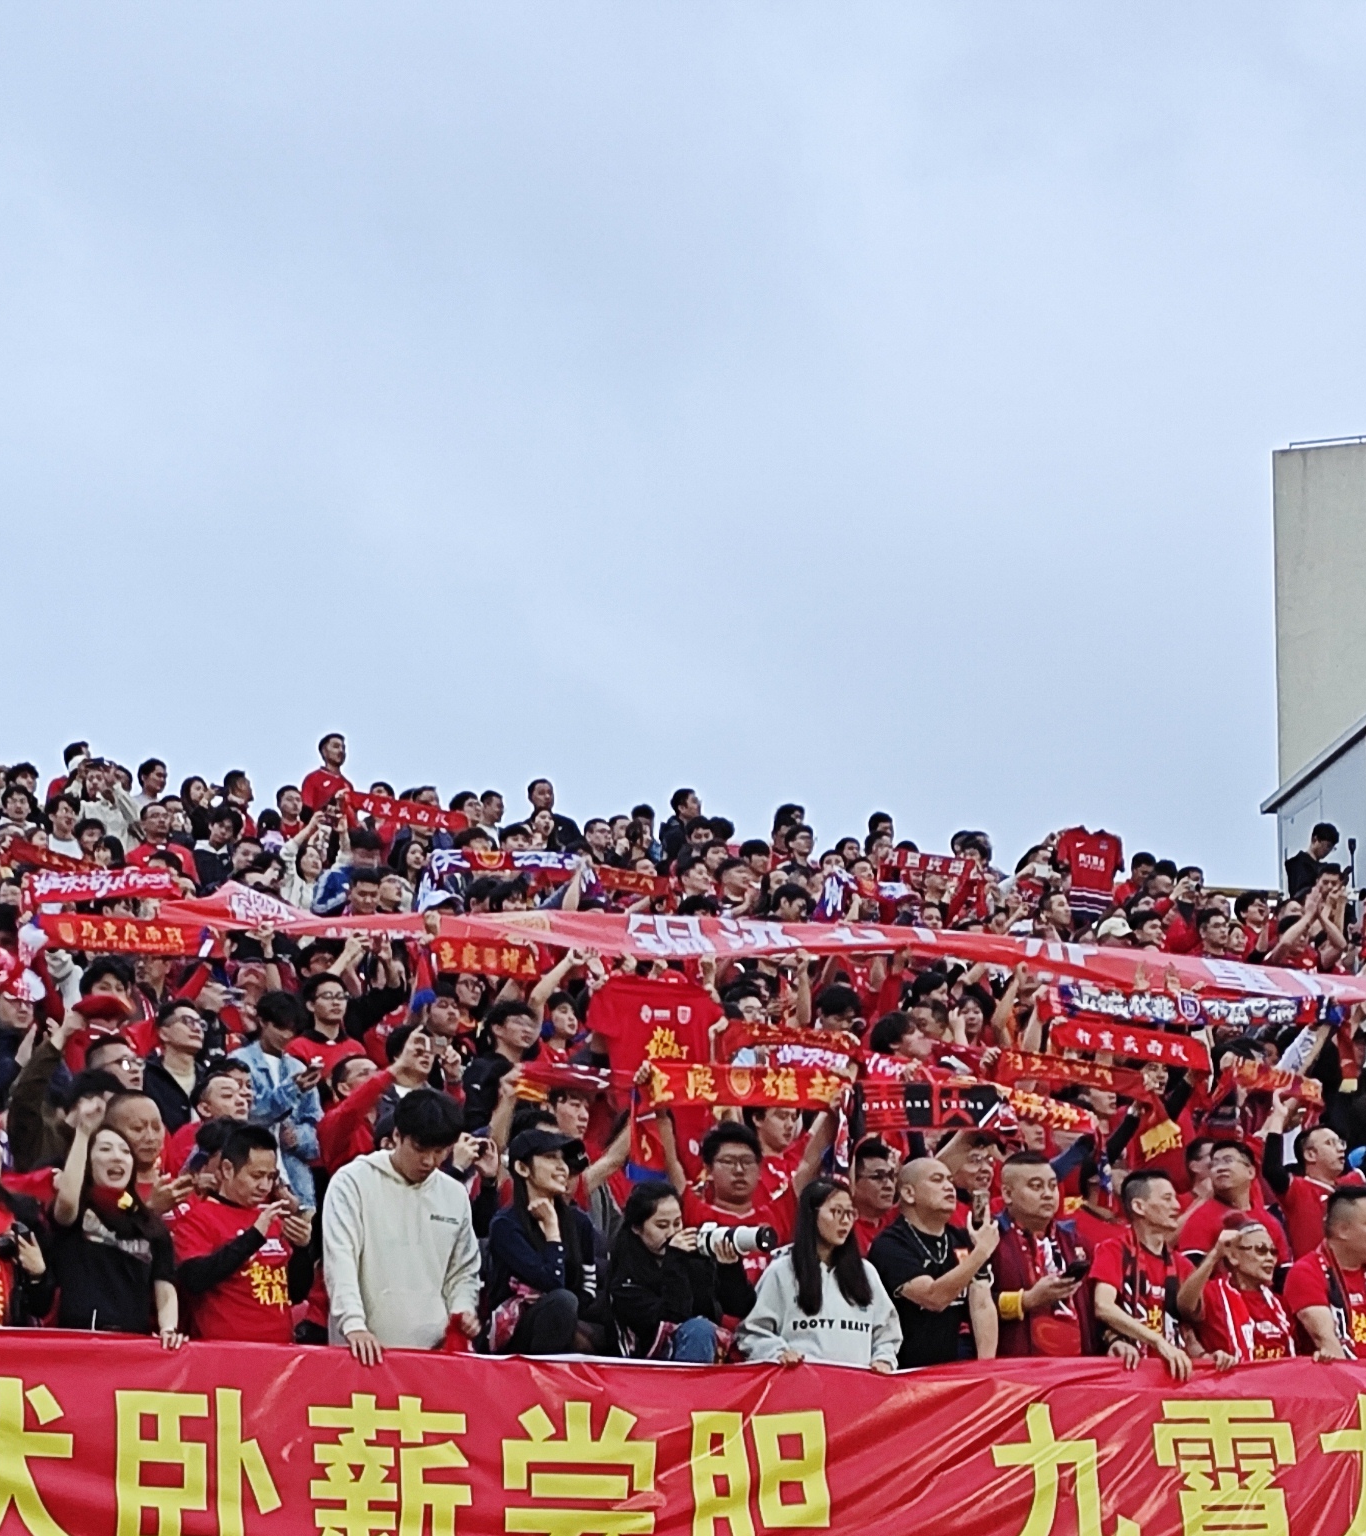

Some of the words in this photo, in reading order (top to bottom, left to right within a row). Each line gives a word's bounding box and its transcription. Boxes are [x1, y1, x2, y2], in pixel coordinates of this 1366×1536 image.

[861, 1099, 931, 1111] ONGLIANG
[792, 1318, 834, 1331] FOOTY
[840, 1320, 870, 1333] BEAST
